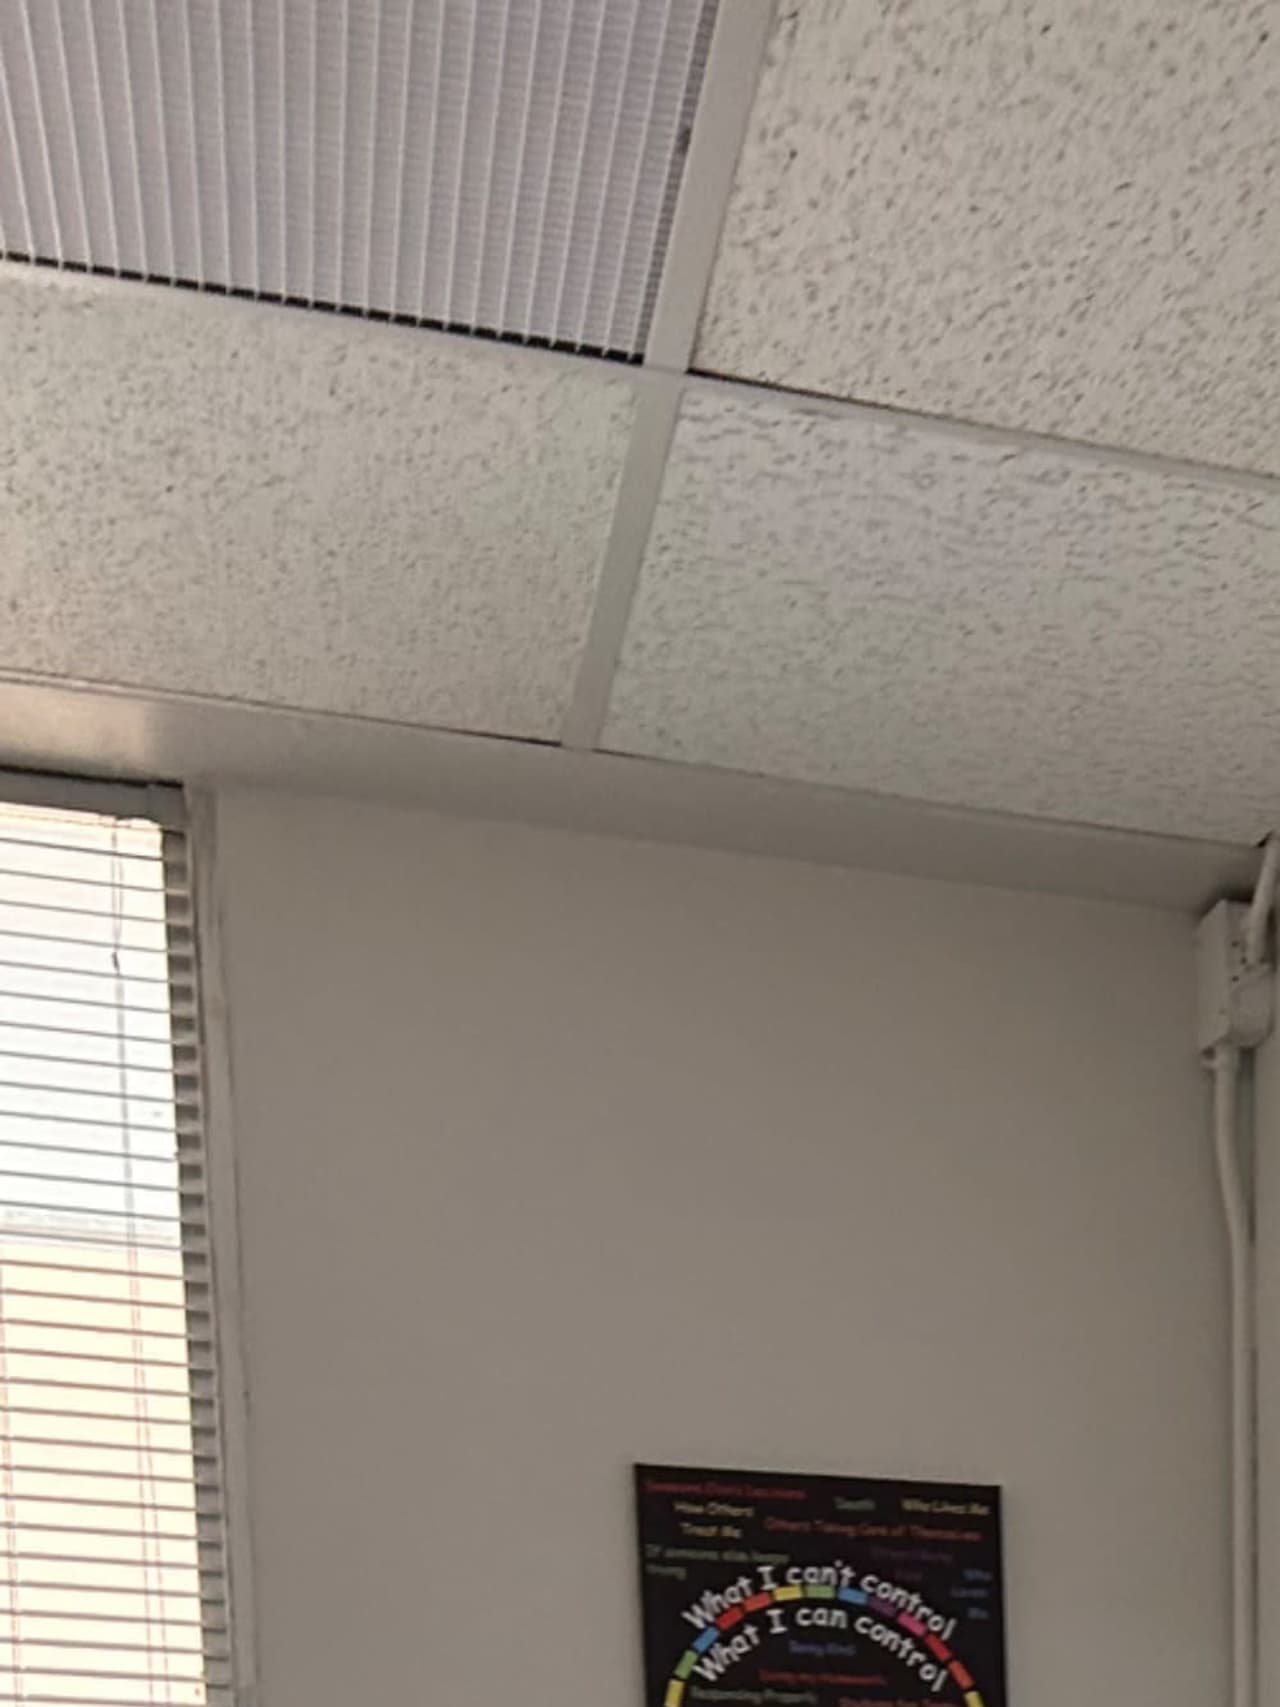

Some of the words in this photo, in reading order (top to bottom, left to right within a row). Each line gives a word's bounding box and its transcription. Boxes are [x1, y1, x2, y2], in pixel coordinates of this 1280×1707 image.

[681, 1576, 752, 1629] What
[757, 1566, 778, 1590] I
[786, 1560, 856, 1585] can't
[860, 1574, 957, 1640] control
[693, 1624, 760, 1682] What
[766, 1609, 787, 1634] I
[796, 1606, 848, 1629] can
[854, 1615, 949, 1692] control
